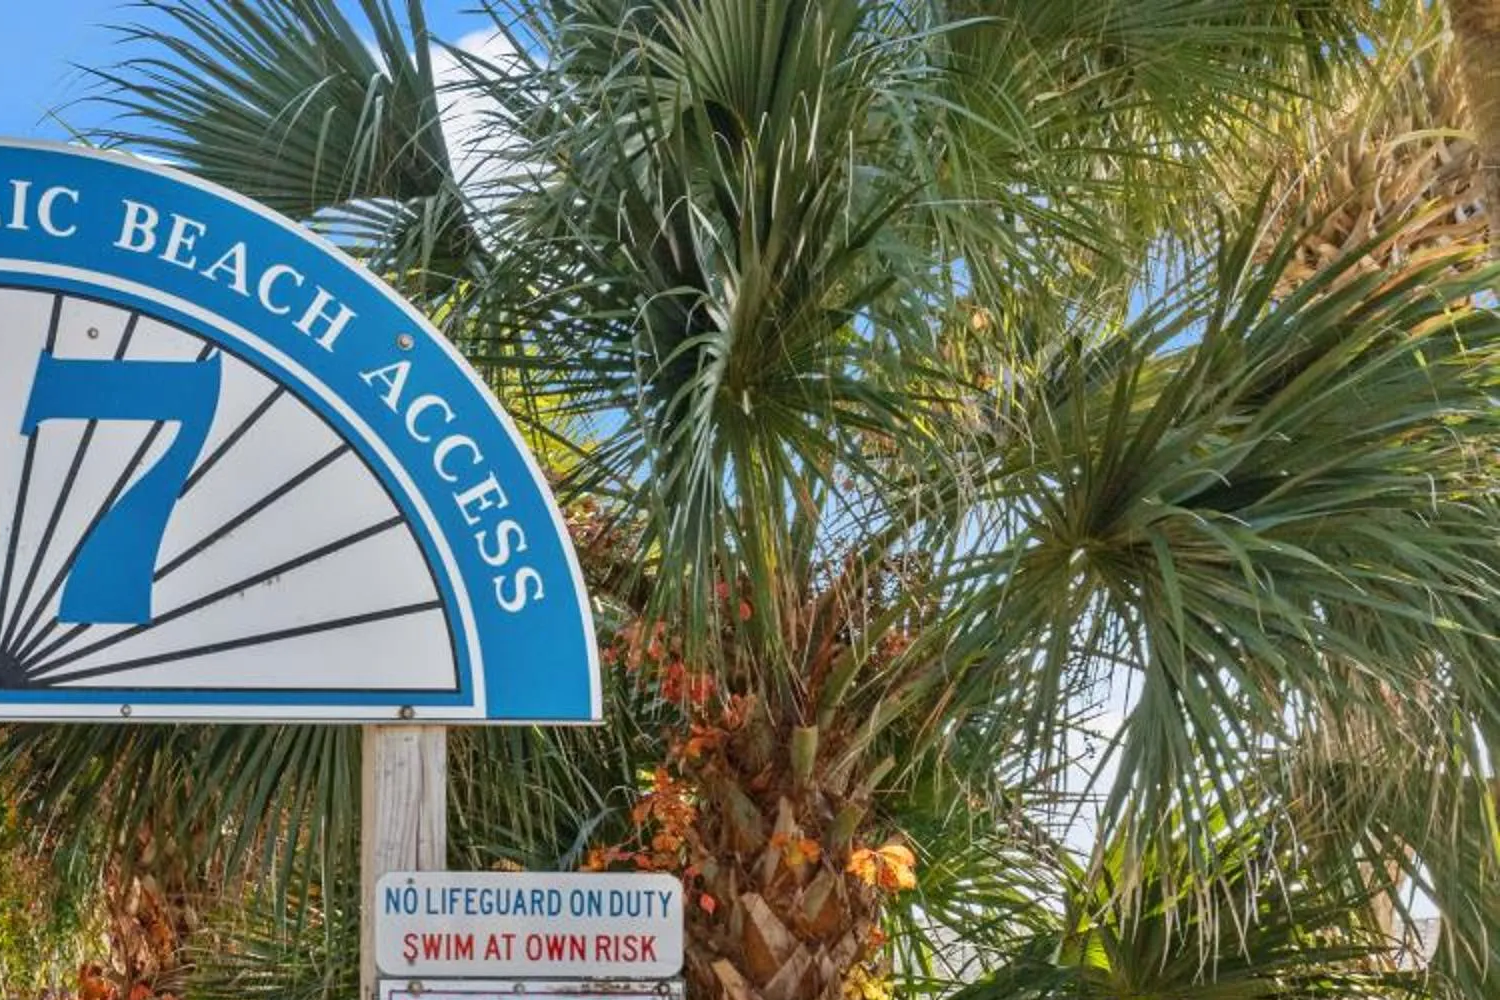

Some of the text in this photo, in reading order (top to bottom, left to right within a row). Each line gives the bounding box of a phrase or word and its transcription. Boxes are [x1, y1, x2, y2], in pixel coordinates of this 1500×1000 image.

[113, 198, 358, 354] BEACH
[359, 357, 546, 615] ACCESS
[385, 887, 672, 918] NO LIFEGUARD ON DUTY
[403, 933, 657, 963] SWIM AT OWN RISK
